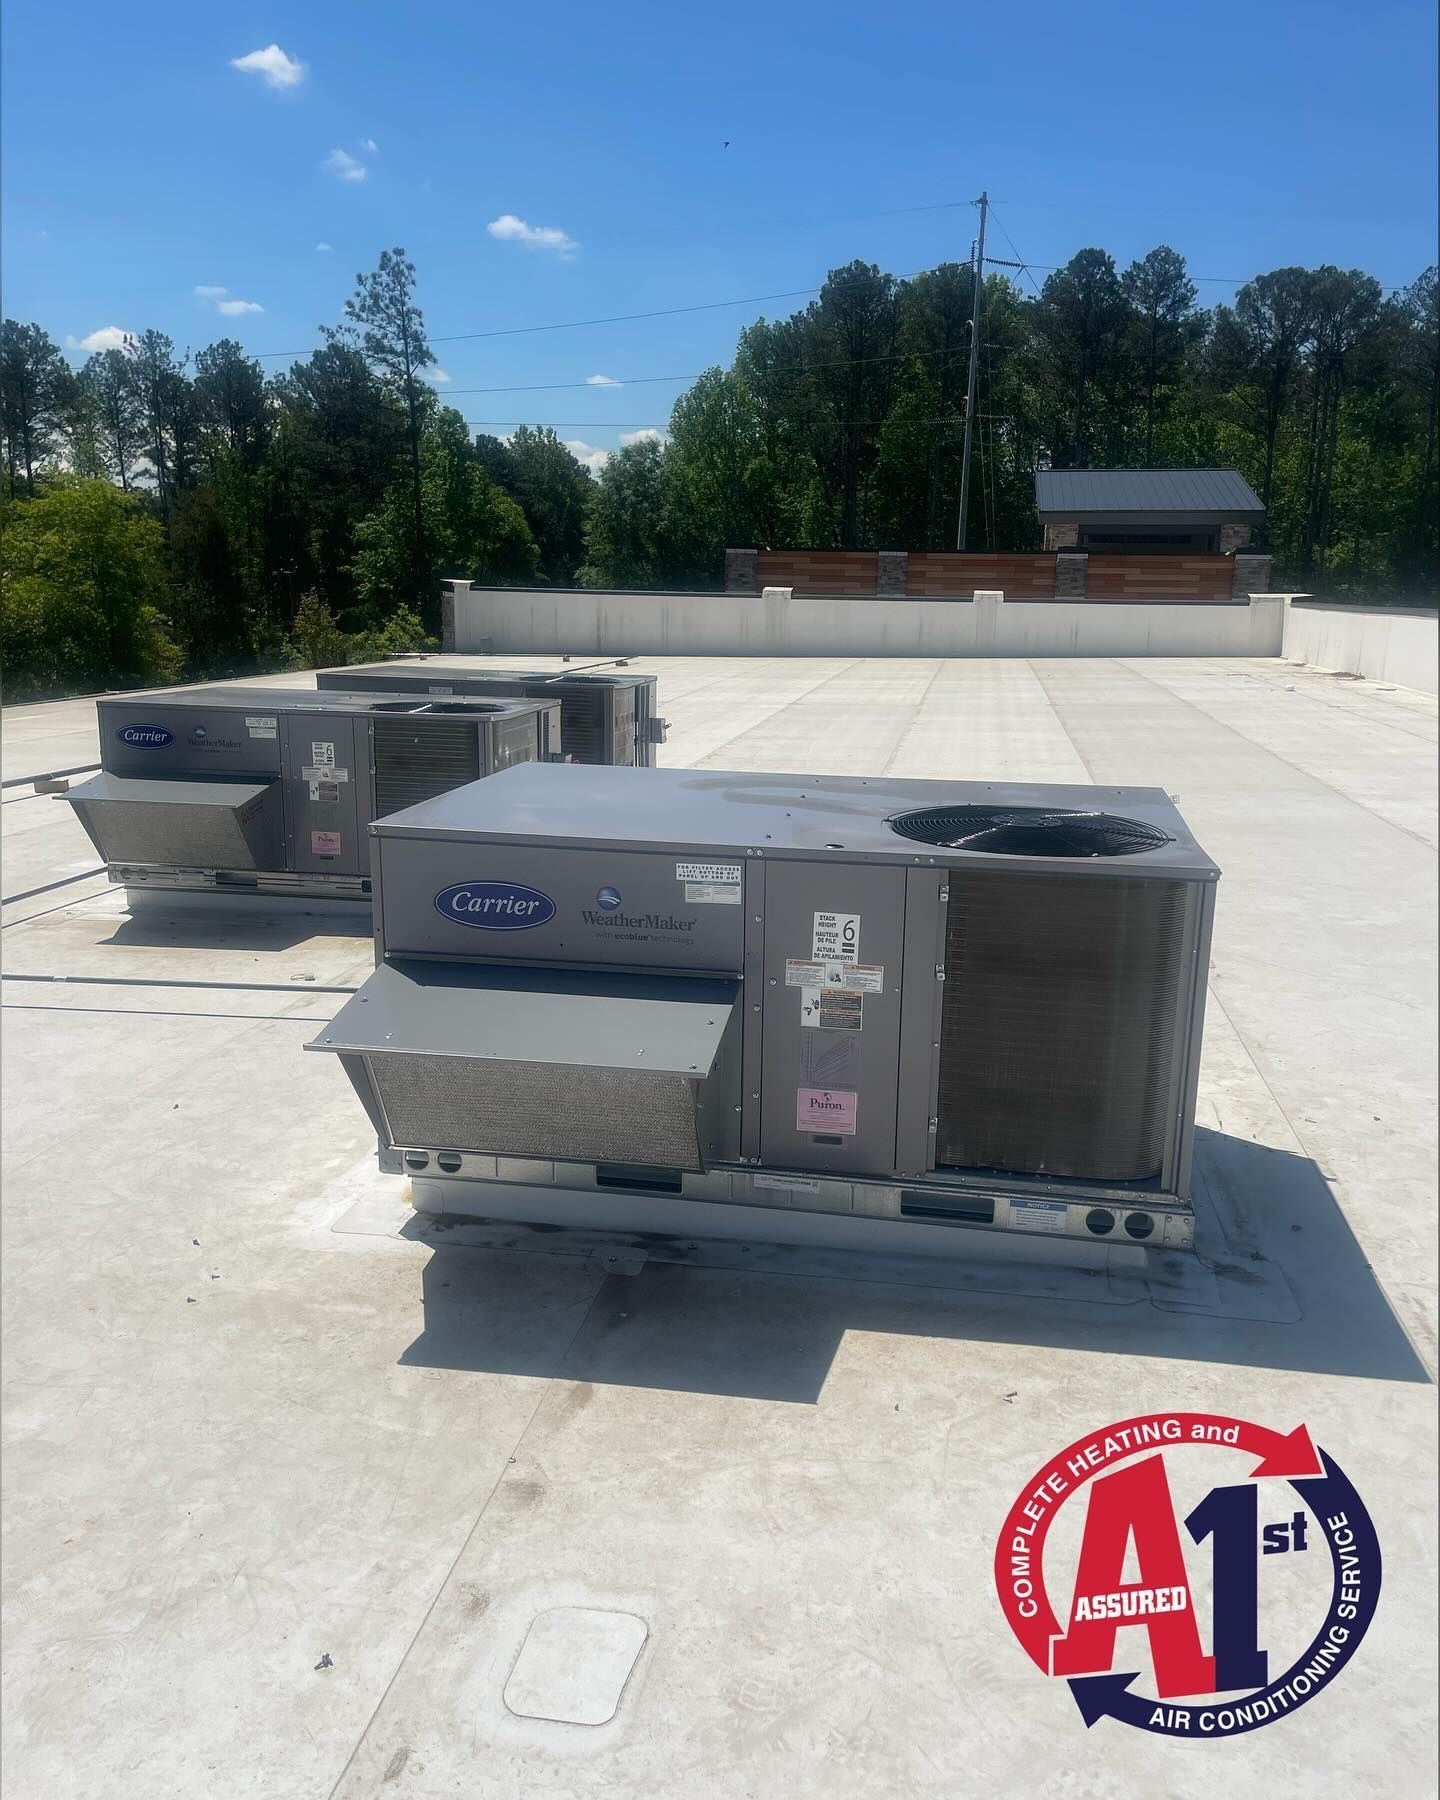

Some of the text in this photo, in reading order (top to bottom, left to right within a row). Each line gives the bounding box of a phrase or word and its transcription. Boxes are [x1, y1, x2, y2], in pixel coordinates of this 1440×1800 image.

[124, 729, 168, 742] Carrier
[326, 744, 333, 756] 6
[450, 891, 540, 915] Carrier
[582, 910, 695, 931] WeatherMaker
[843, 920, 855, 941] 6
[820, 953, 854, 961] APILAMIENTO
